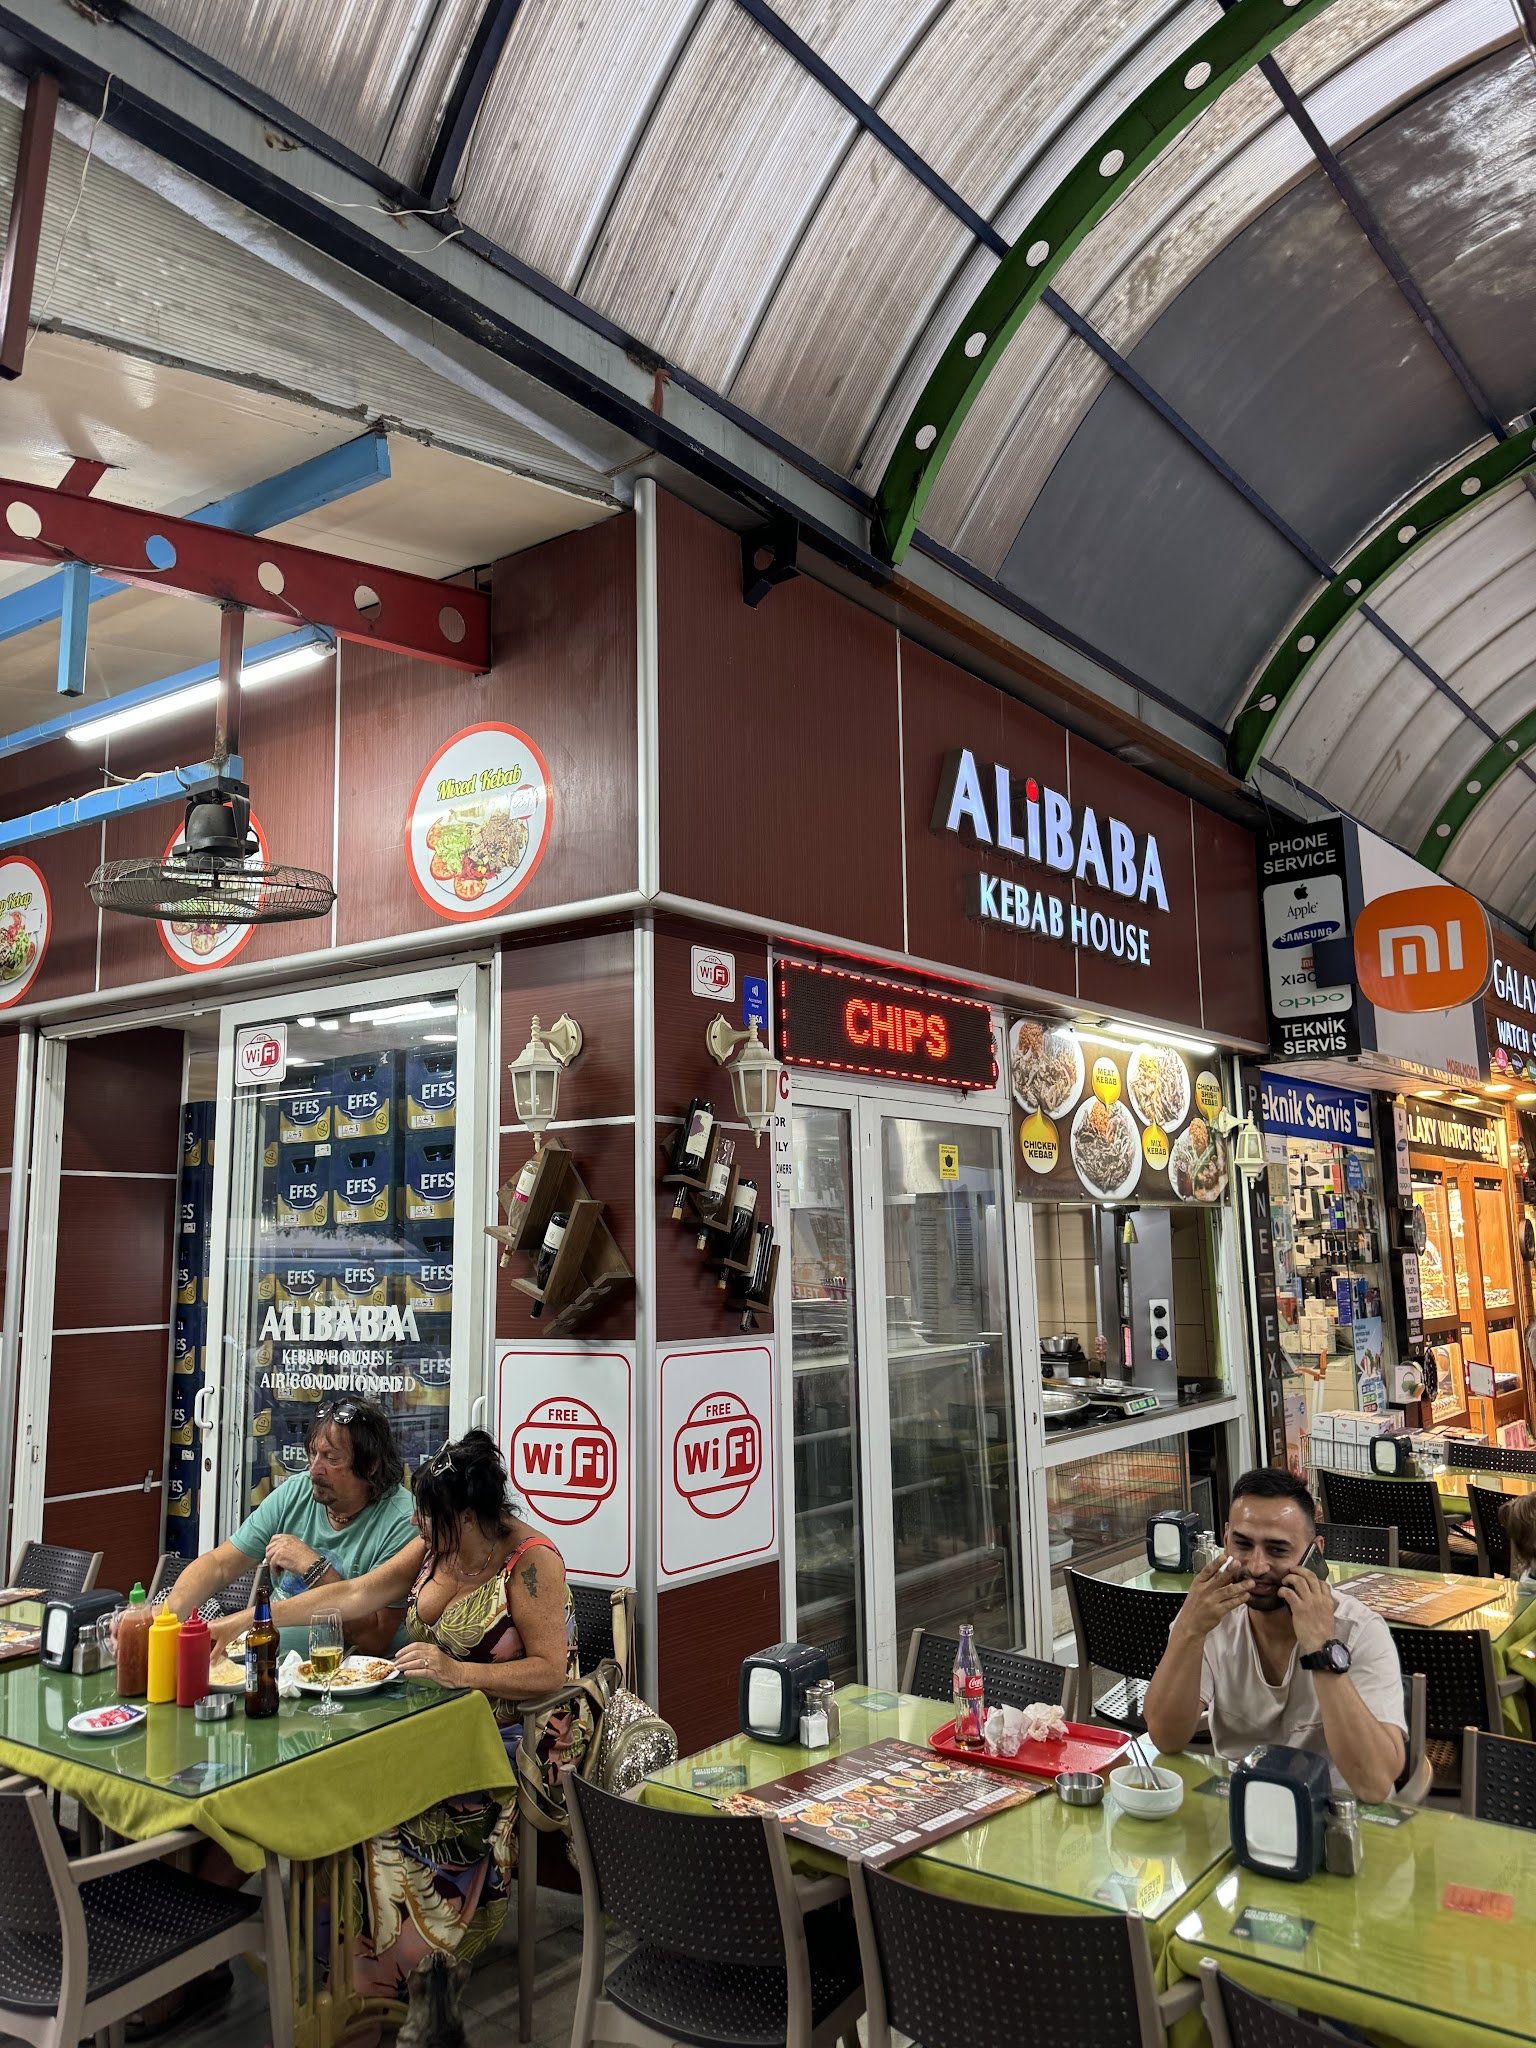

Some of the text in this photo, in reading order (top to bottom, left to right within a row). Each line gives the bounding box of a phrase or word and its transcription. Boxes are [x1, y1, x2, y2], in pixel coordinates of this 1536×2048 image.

[437, 764, 522, 801] Mixed Kebab
[1269, 833, 1329, 856] PHONE
[1263, 849, 1337, 875] SERVICE
[7, 892, 32, 910] Kebap
[979, 872, 1151, 966] KEBAB HOUSE
[1287, 902, 1318, 920] Apple
[1280, 926, 1333, 943] SAMSUNG
[1281, 971, 1316, 986] xiao
[1279, 992, 1345, 1008] oppo
[845, 998, 948, 1059] CHIPS
[1281, 1016, 1347, 1039] TEKNİK
[1496, 1017, 1530, 1054] WATCH
[1283, 1033, 1347, 1055] SERVİS
[1097, 1067, 1115, 1076] MEAT
[1096, 1076, 1117, 1086] KEBAB
[1197, 1082, 1220, 1092] CHICKEN
[422, 1081, 455, 1099] EFES
[1201, 1090, 1218, 1098] SHISH
[291, 1099, 320, 1116] EFES
[347, 1091, 377, 1109] EFES
[1200, 1098, 1218, 1107] KEBAB
[1262, 1085, 1351, 1133] eknik Servis
[1407, 1113, 1496, 1154] LAXY WATCH SHOP
[1023, 1140, 1057, 1151] CHICKEN
[1146, 1146, 1167, 1156] KEBAB
[1150, 1138, 1162, 1147] MIX
[1028, 1149, 1053, 1159] KEBAB
[1248, 1085, 1269, 1254] PNE
[346, 1177, 376, 1195] EFES
[421, 1172, 454, 1190] EFES
[289, 1183, 317, 1200] EFES
[287, 1269, 315, 1286] EFES
[345, 1267, 375, 1284] EFES
[421, 1264, 453, 1282] EFES
[282, 1349, 327, 1365] KEBAB
[1265, 1315, 1283, 1455] EXPE
[548, 1408, 579, 1422] FREE
[706, 1402, 731, 1418] FREE
